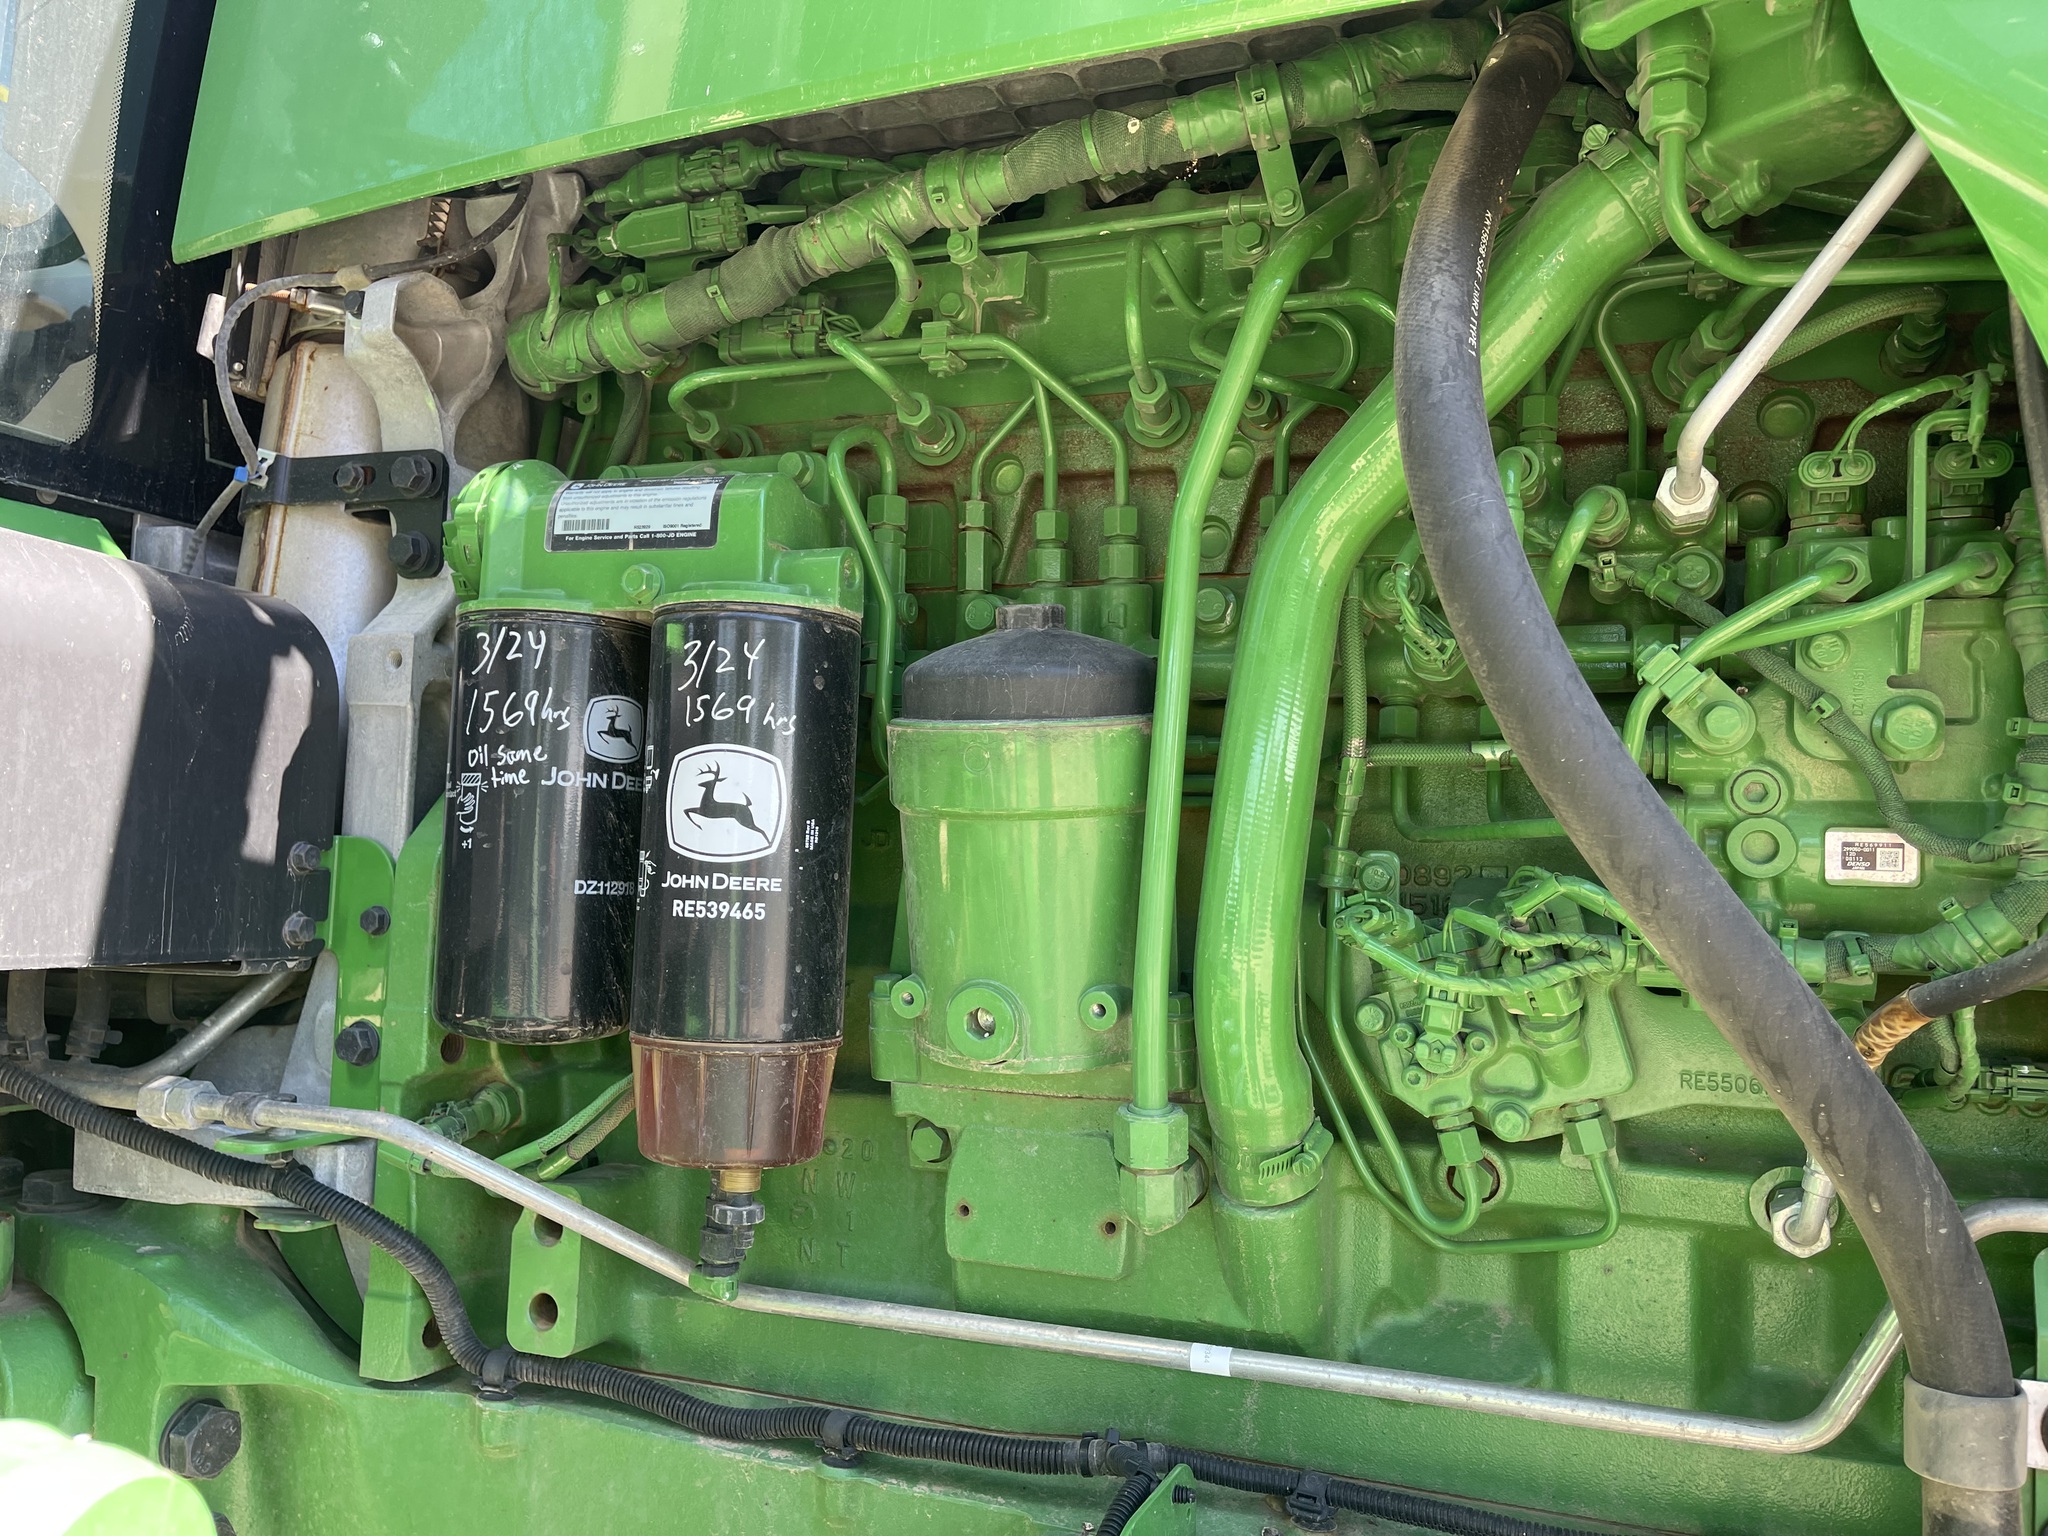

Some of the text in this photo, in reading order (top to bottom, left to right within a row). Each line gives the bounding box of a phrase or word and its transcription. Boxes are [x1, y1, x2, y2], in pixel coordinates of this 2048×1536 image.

[676, 531, 697, 539] ENGINE
[471, 626, 547, 676] 3/24
[678, 638, 767, 692] 3/24
[684, 691, 798, 736] 1569 hrs
[497, 744, 549, 767] same
[490, 766, 531, 788] time
[541, 766, 645, 792] JOHN DEE
[573, 879, 636, 897] DZ112918
[661, 871, 783, 893] JOHN DEERE
[671, 899, 767, 921] RE539465
[1679, 1069, 1768, 1096] RE5506
